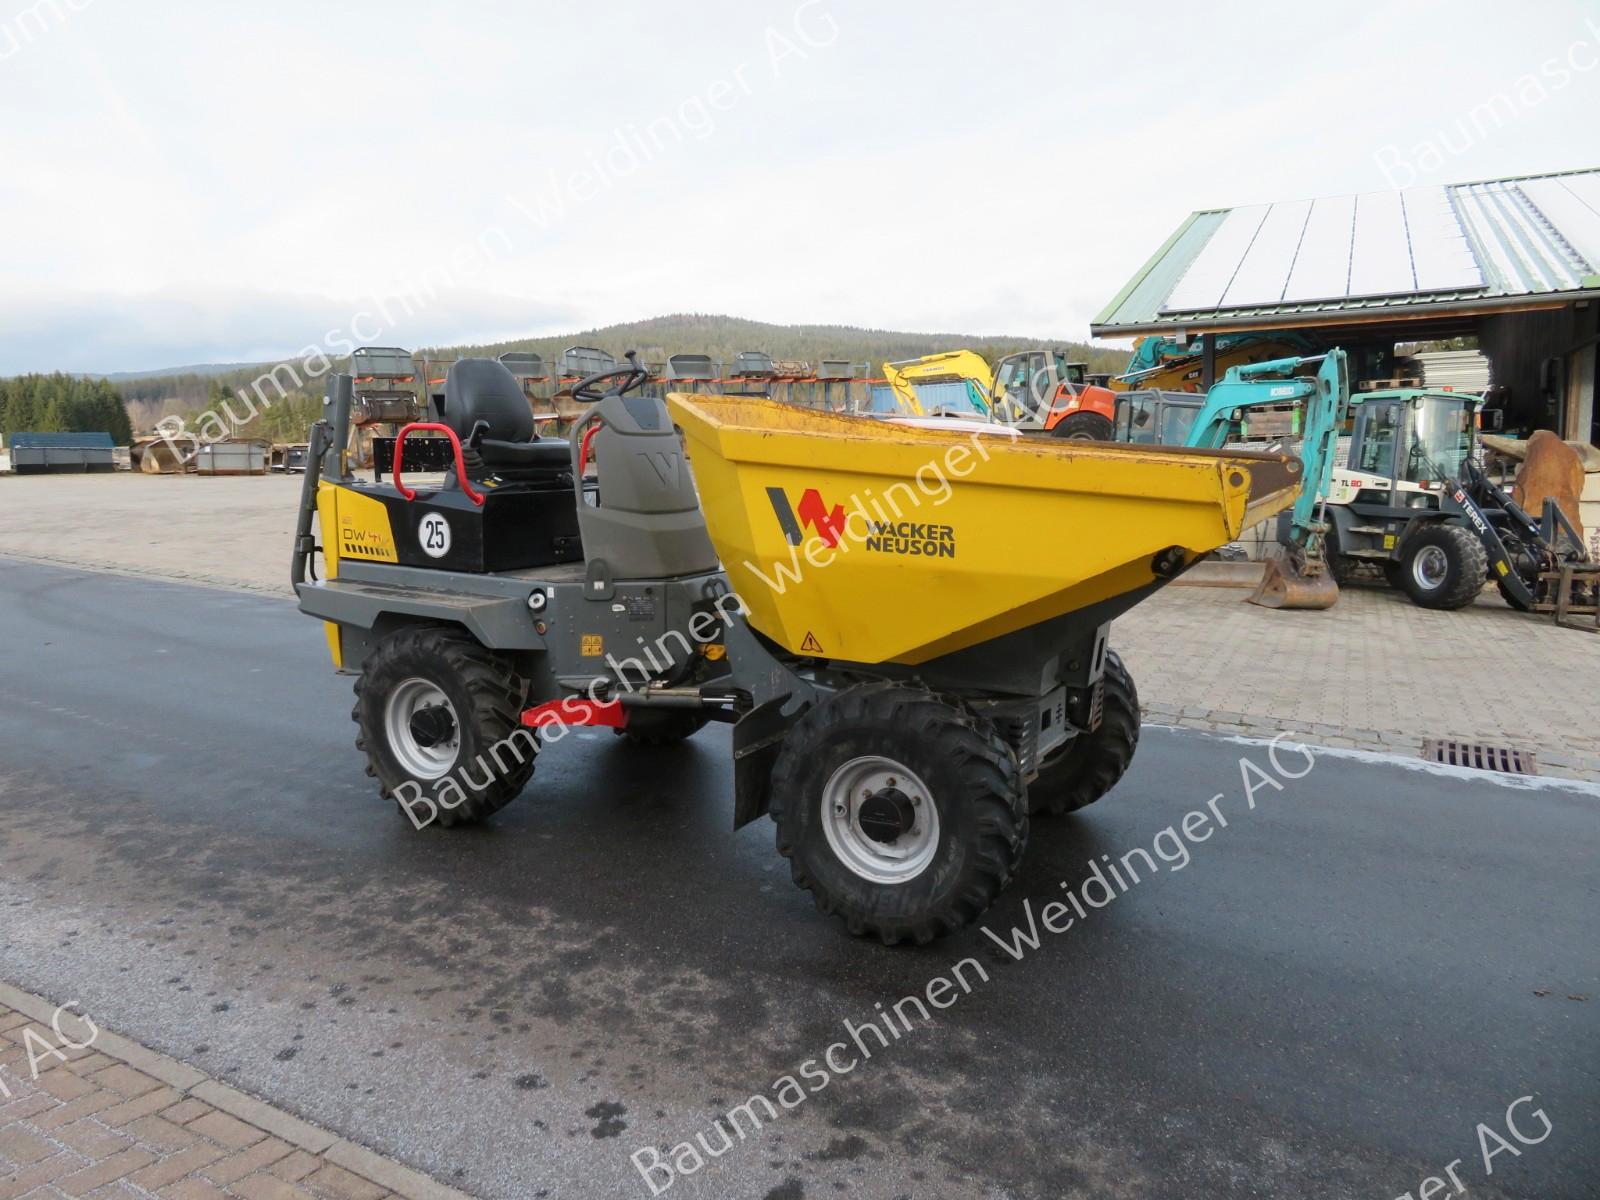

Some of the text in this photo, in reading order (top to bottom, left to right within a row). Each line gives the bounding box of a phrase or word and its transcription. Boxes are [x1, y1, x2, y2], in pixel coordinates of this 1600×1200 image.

[1462, 499, 1488, 535] TEREX
[426, 520, 445, 549] 25
[865, 519, 955, 542] WACKER
[866, 537, 955, 558] NEUSON
